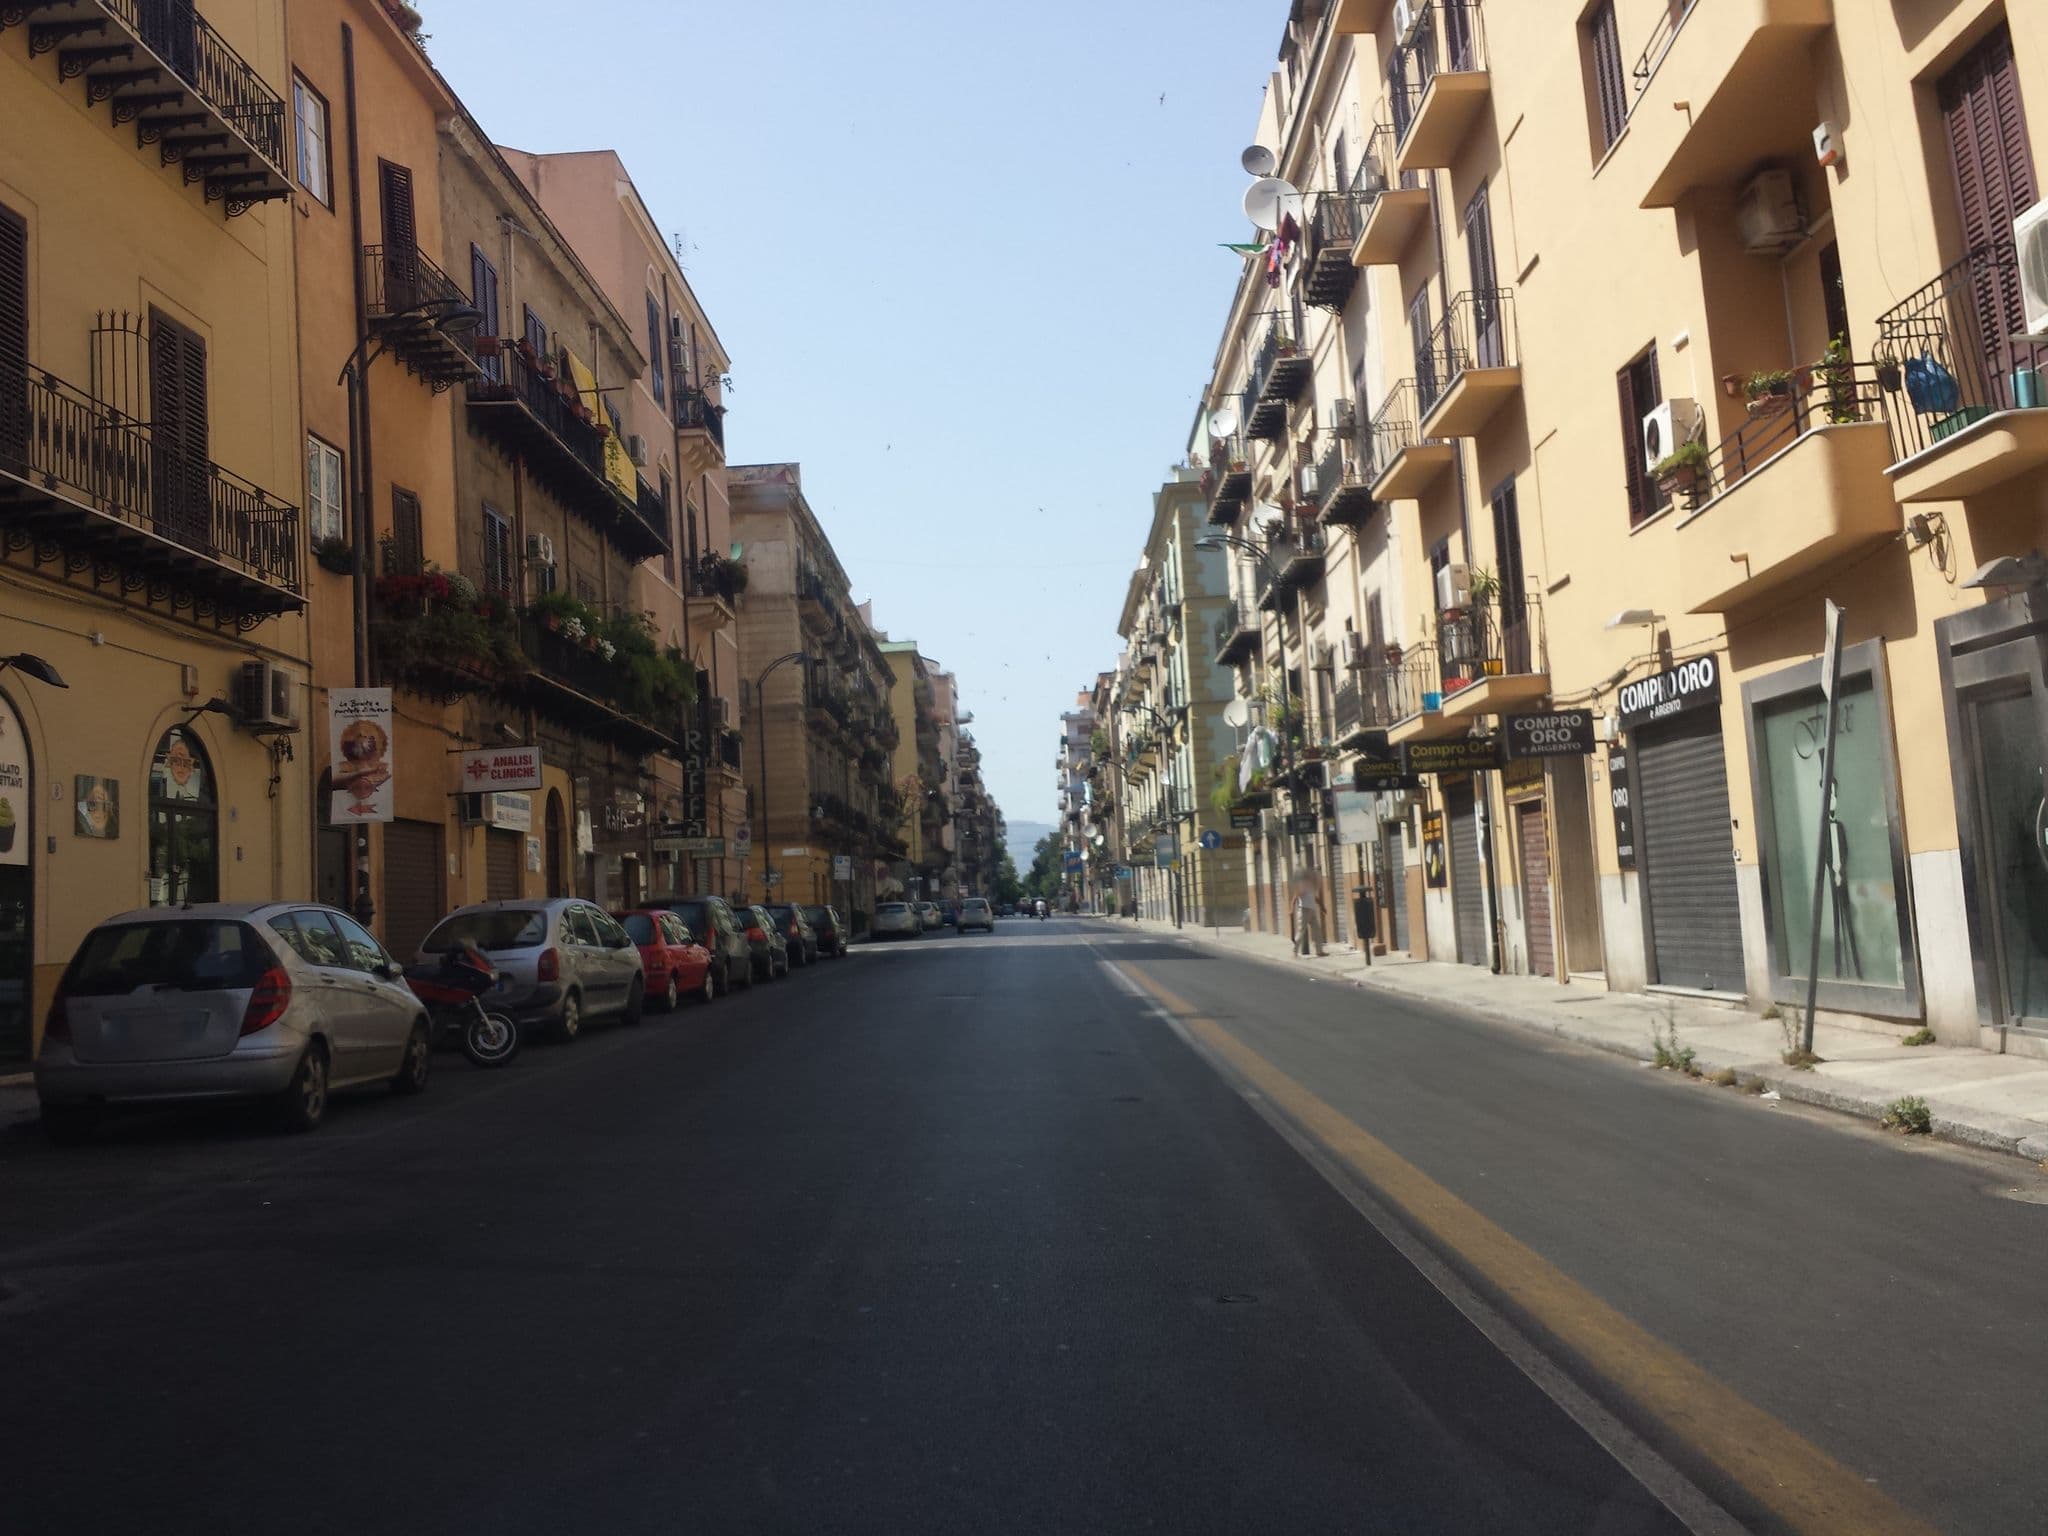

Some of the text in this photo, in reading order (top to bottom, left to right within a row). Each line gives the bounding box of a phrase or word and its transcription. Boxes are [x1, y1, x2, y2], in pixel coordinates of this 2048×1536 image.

[1620, 657, 1714, 714] COMPRO ORO
[1649, 699, 1681, 720] e ARGENTO
[1514, 714, 1582, 732] COMPRO
[1530, 728, 1572, 744] ORO
[1409, 743, 1466, 757] Compro
[1530, 742, 1581, 753] ARGENTO
[493, 754, 532, 767] ANALISI
[490, 767, 536, 780] CLINICHE
[1612, 787, 1629, 808] ORO
